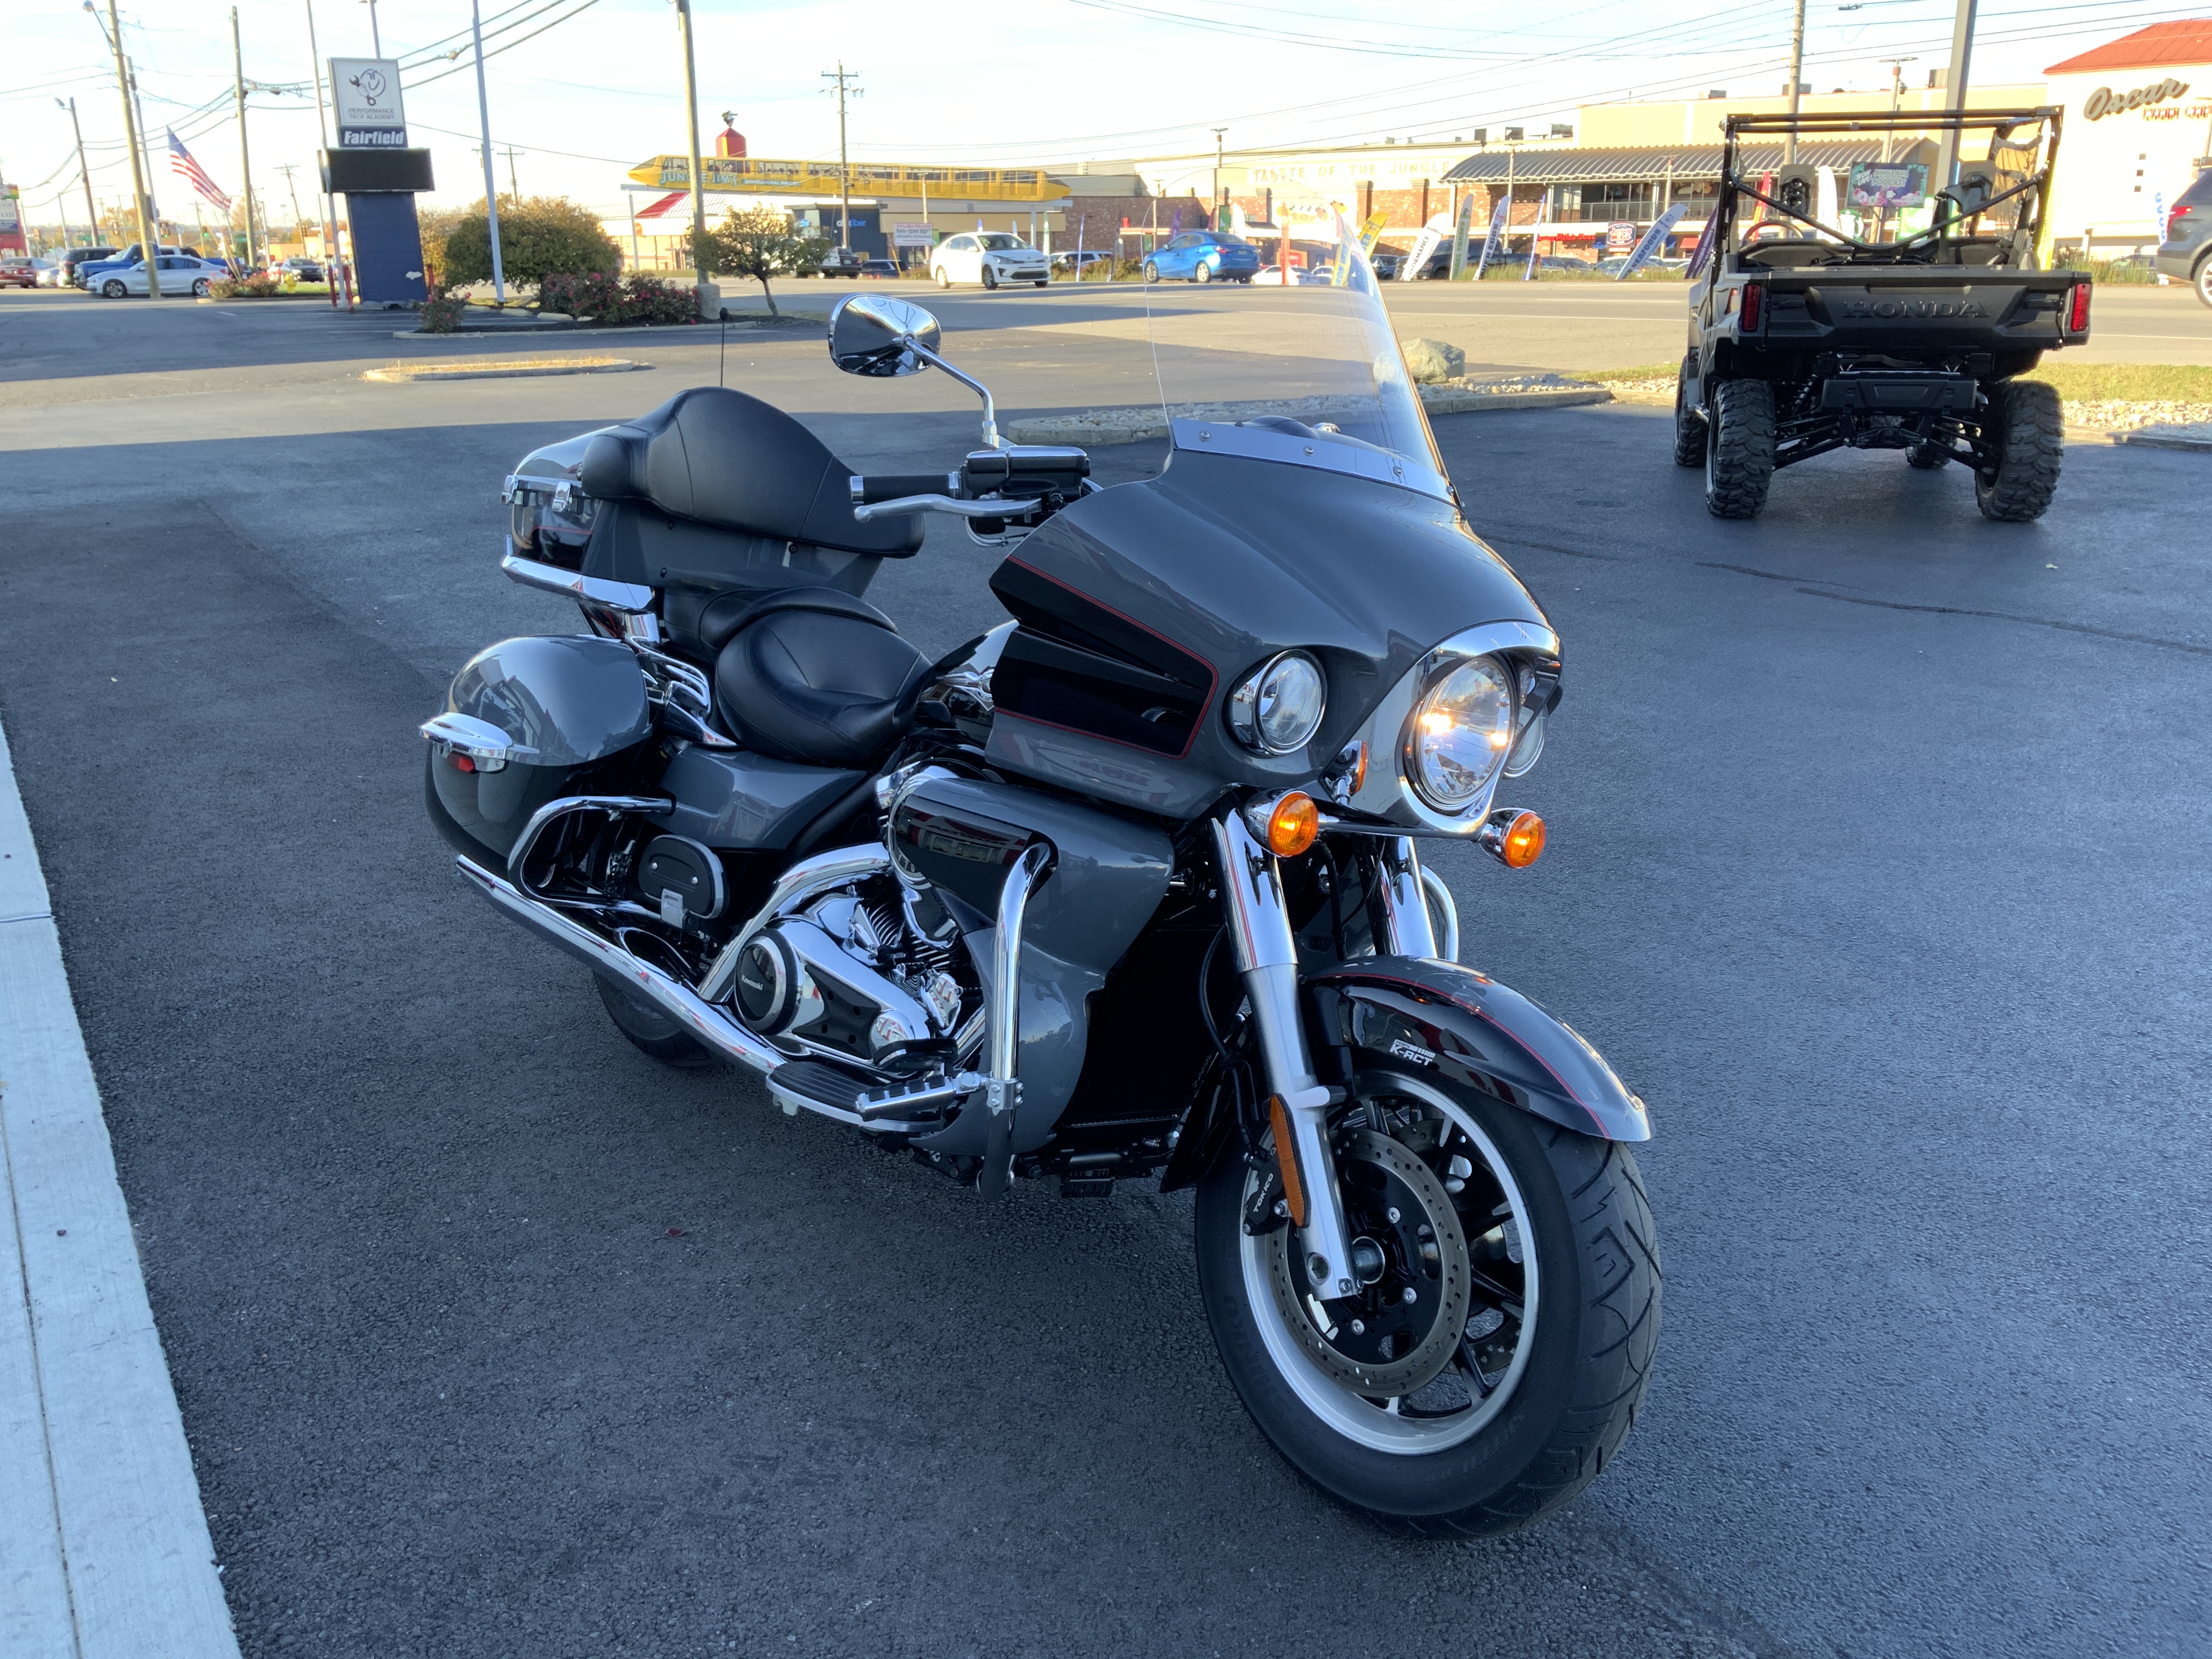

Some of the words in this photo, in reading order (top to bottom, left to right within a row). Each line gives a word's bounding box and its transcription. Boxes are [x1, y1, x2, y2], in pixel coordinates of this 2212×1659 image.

[2084, 78, 2190, 121] Oscar
[344, 131, 404, 144] Fairfield
[659, 172, 707, 185] JUNE
[1253, 167, 1306, 182] TASTE
[1318, 166, 1336, 177] OF
[1348, 165, 1376, 175] THE
[1390, 161, 1450, 174] JUNGLE
[1857, 169, 1871, 180] NOW
[1871, 178, 1907, 187] PODCAST
[1488, 223, 1498, 250] EGGS
[1632, 228, 1661, 268] SEAFOODS
[1843, 301, 1989, 318] HONDA
[742, 974, 763, 990] Kawasaki
[1390, 1043, 1433, 1065] K-ACT
[1254, 1173, 1274, 1212] TOKICO
